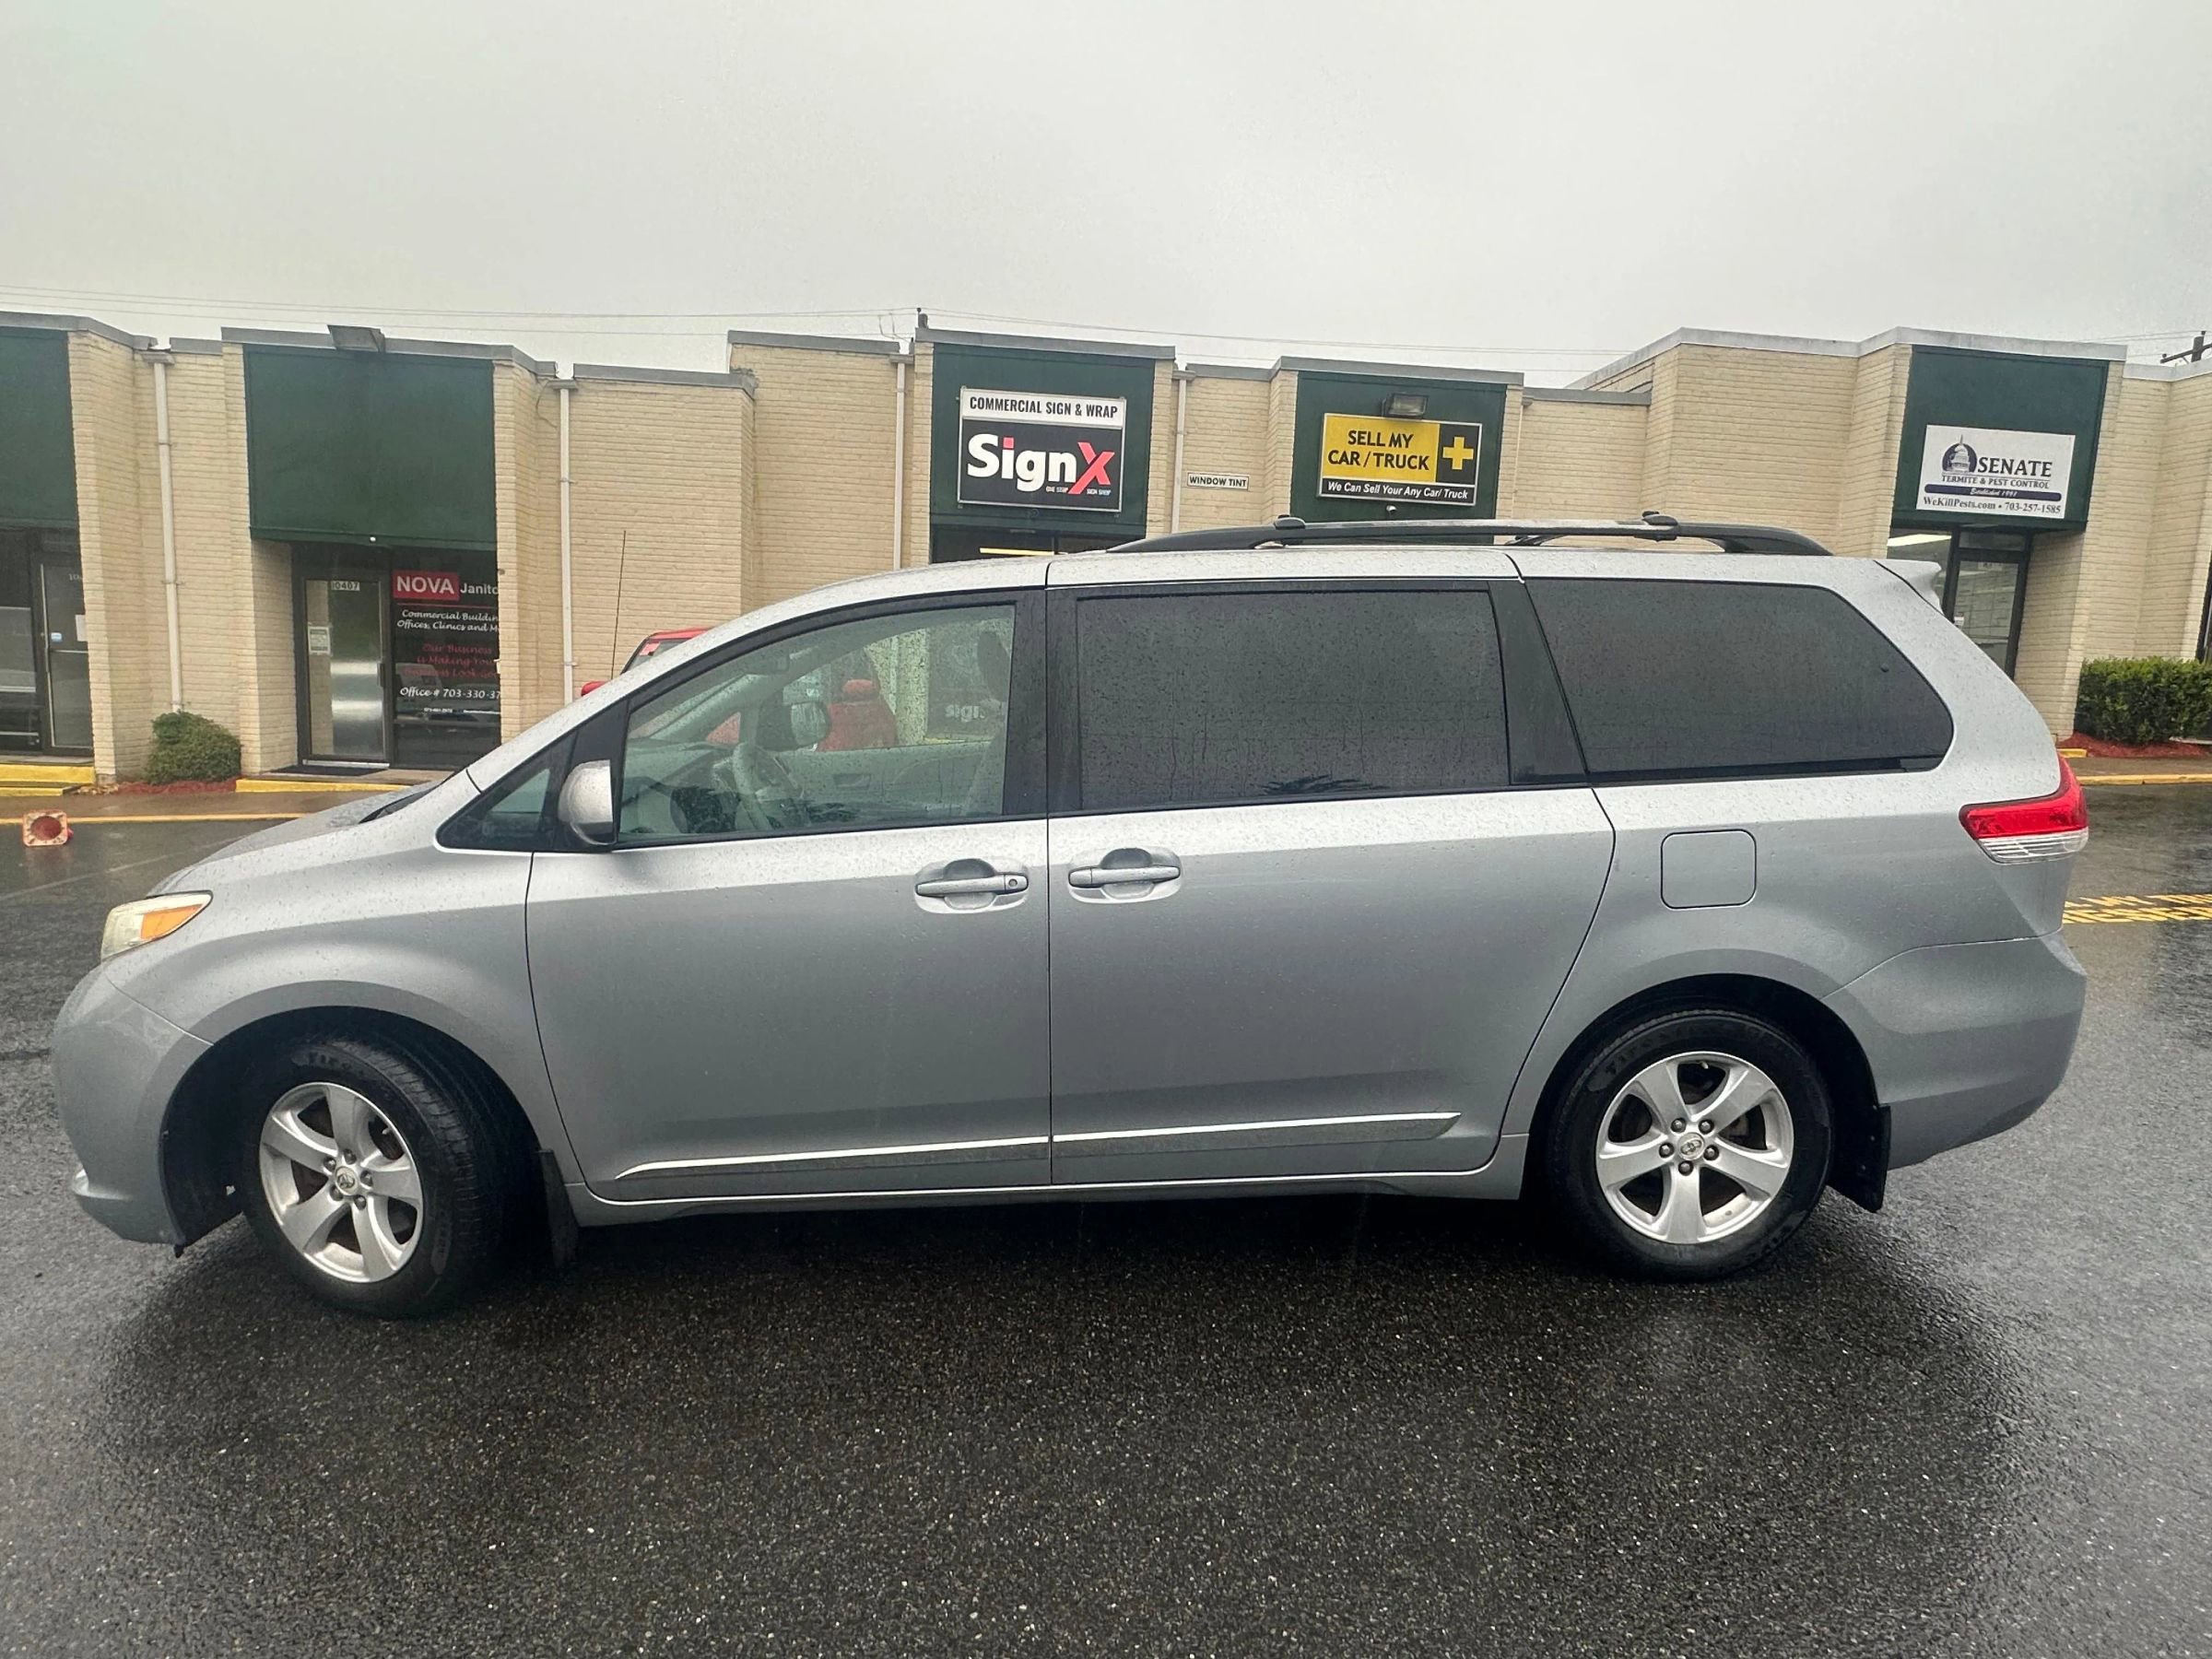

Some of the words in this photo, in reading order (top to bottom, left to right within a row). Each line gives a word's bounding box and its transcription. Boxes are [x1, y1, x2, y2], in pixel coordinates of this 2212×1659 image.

[970, 396, 1041, 414] COMMERCIAL
[1046, 402, 1071, 416] SIGN
[1075, 404, 1082, 416] &
[1086, 405, 1118, 418] WRAP
[1347, 429, 1385, 447] SELL
[1388, 432, 1414, 449] MY
[968, 433, 1115, 495] SignX
[1328, 450, 1360, 465] CAR
[1373, 453, 1430, 470] TRUCK
[1978, 456, 2053, 477] SENATE
[1189, 476, 1227, 487] WINDOW
[1229, 478, 1247, 488] TINT
[1327, 481, 1342, 491] We
[1344, 482, 1361, 493] Can
[1363, 484, 1380, 494] Sell
[1382, 485, 1403, 495] Your
[1404, 486, 1421, 498] Any
[1443, 489, 1468, 500] Truck
[1941, 475, 1978, 485] TERMITE
[1988, 477, 2008, 487] PEST
[2010, 479, 2050, 489] CONTROL
[1923, 496, 1996, 510] WeKillPests.com
[2005, 501, 2061, 514] 703-257-1585
[396, 575, 454, 594] NOVA
[402, 609, 460, 620] Commercial
[466, 623, 487, 631] and
[399, 687, 433, 699] Office
